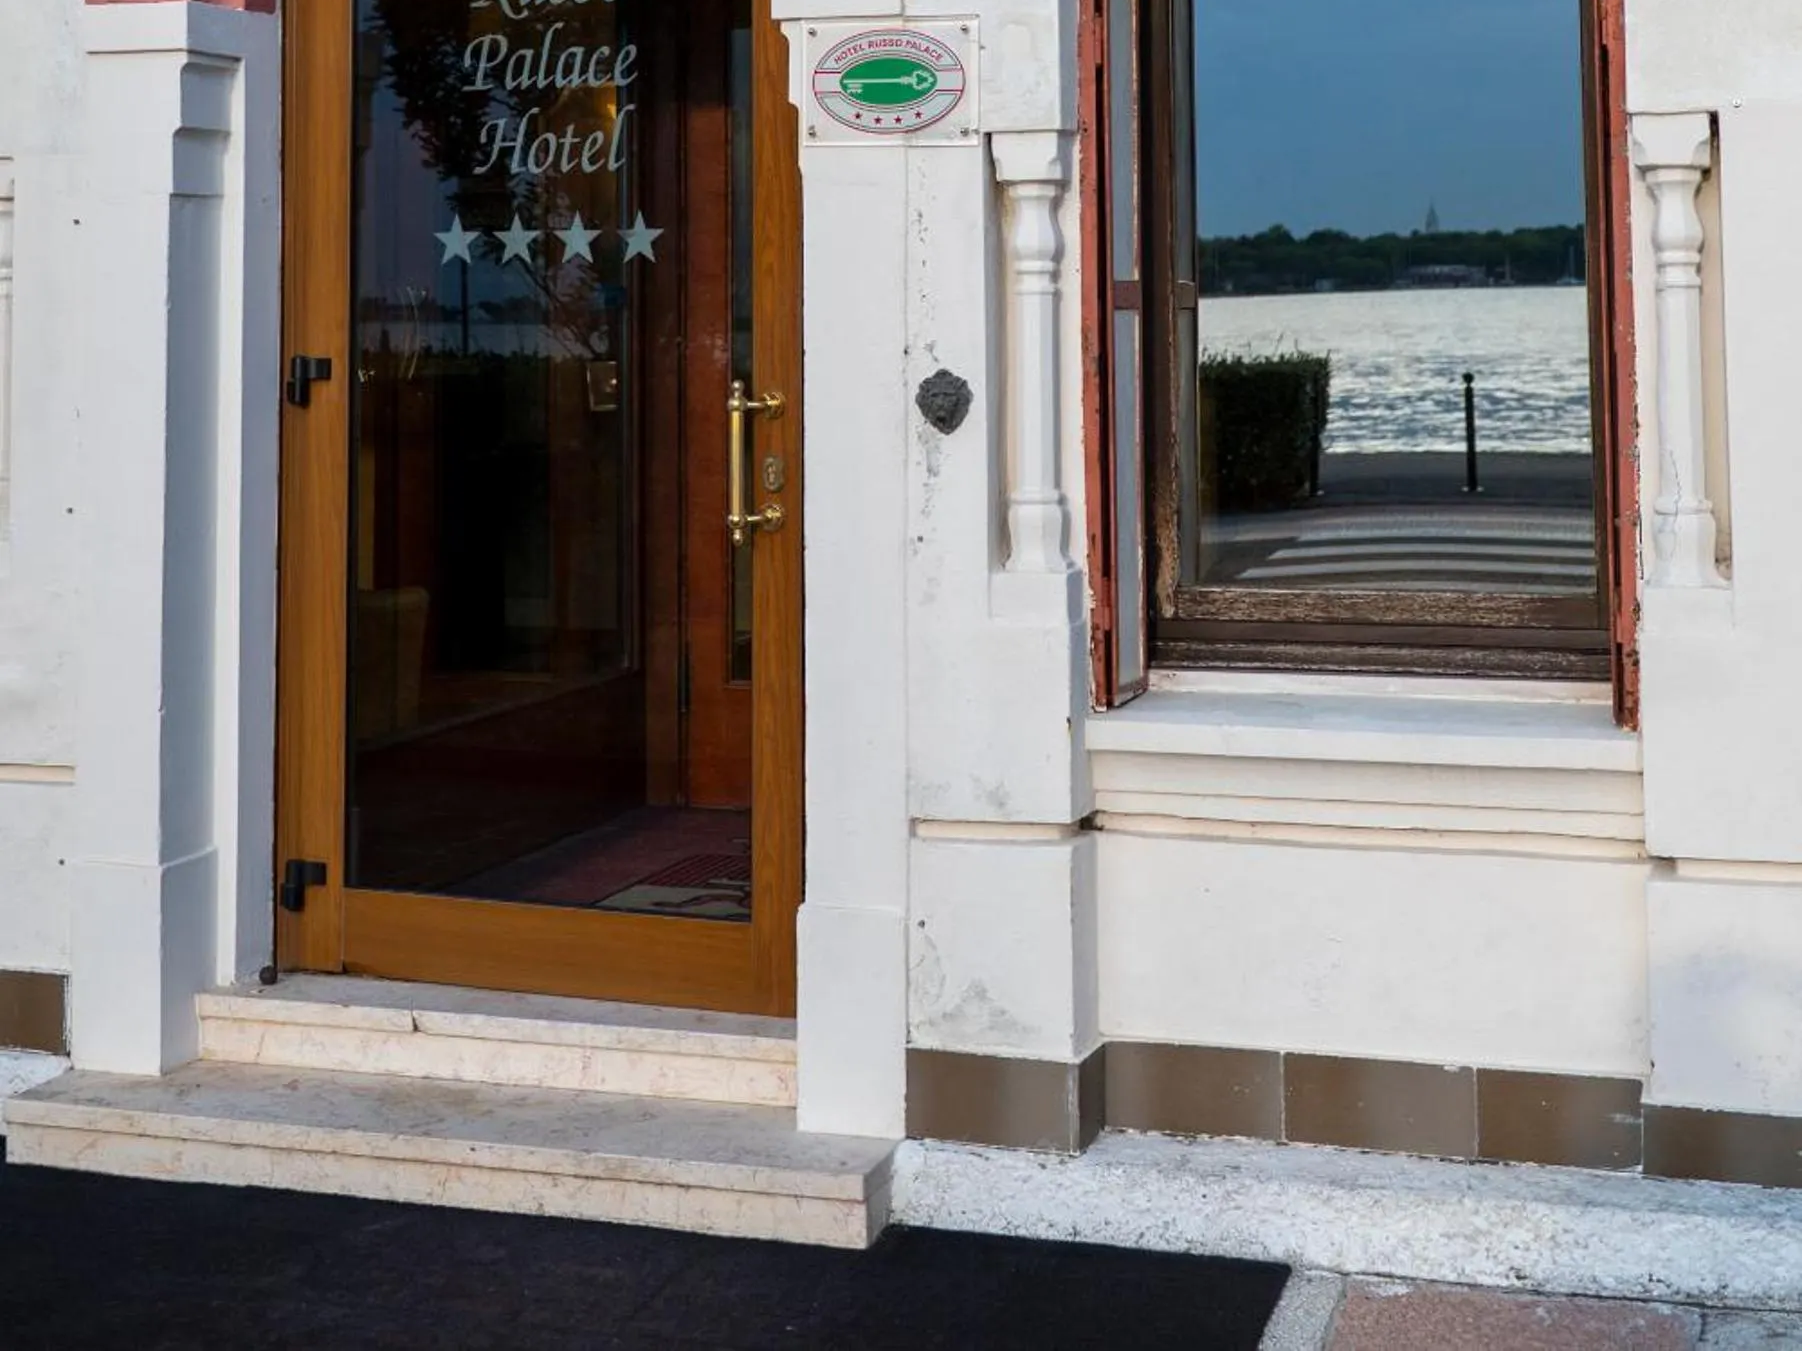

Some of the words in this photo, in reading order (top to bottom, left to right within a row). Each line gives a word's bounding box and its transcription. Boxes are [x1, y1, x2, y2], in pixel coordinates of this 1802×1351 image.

[461, 22, 639, 92] Palace
[834, 43, 865, 64] HOTEL
[867, 38, 904, 49] RUSSO
[905, 39, 944, 63] PALACE
[473, 103, 636, 175] Hotel
